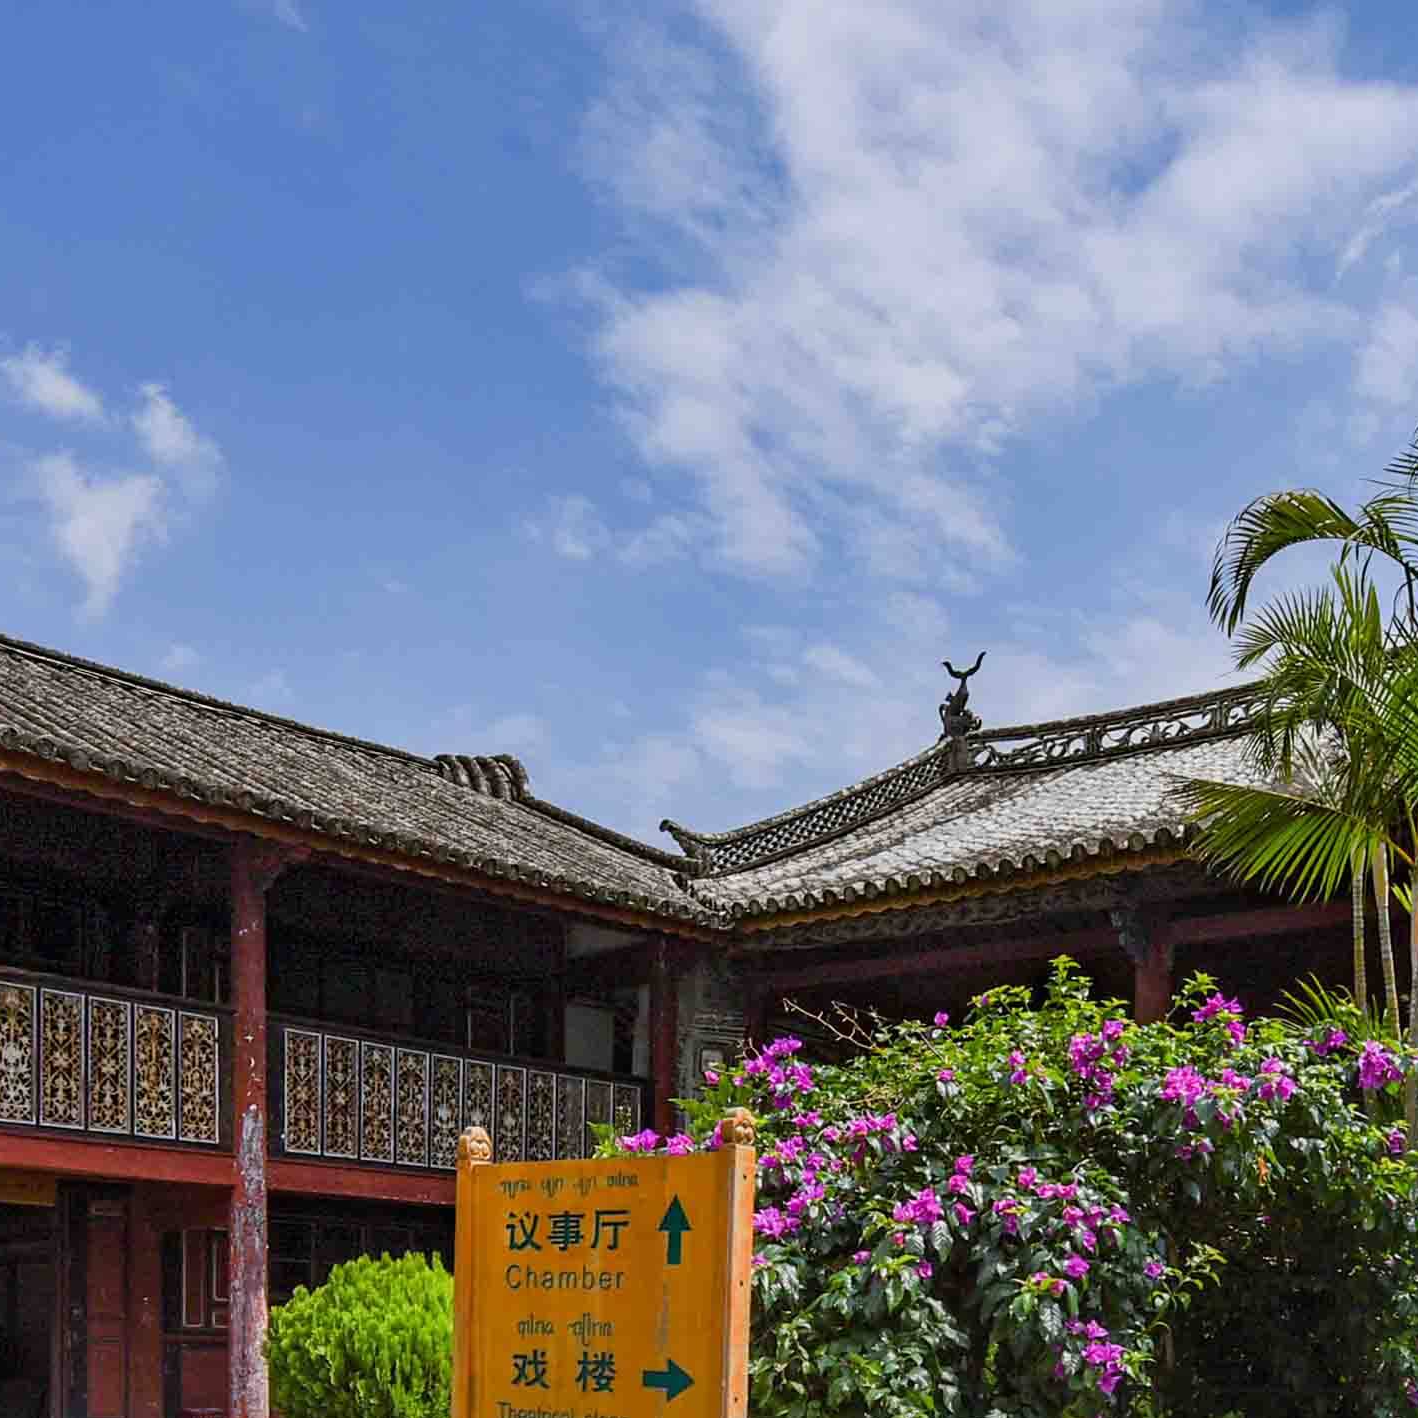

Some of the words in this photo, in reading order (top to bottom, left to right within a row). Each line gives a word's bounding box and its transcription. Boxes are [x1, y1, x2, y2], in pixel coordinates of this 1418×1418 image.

[505, 1209, 631, 1252] 议事厅
[505, 1264, 624, 1291] Chamber
